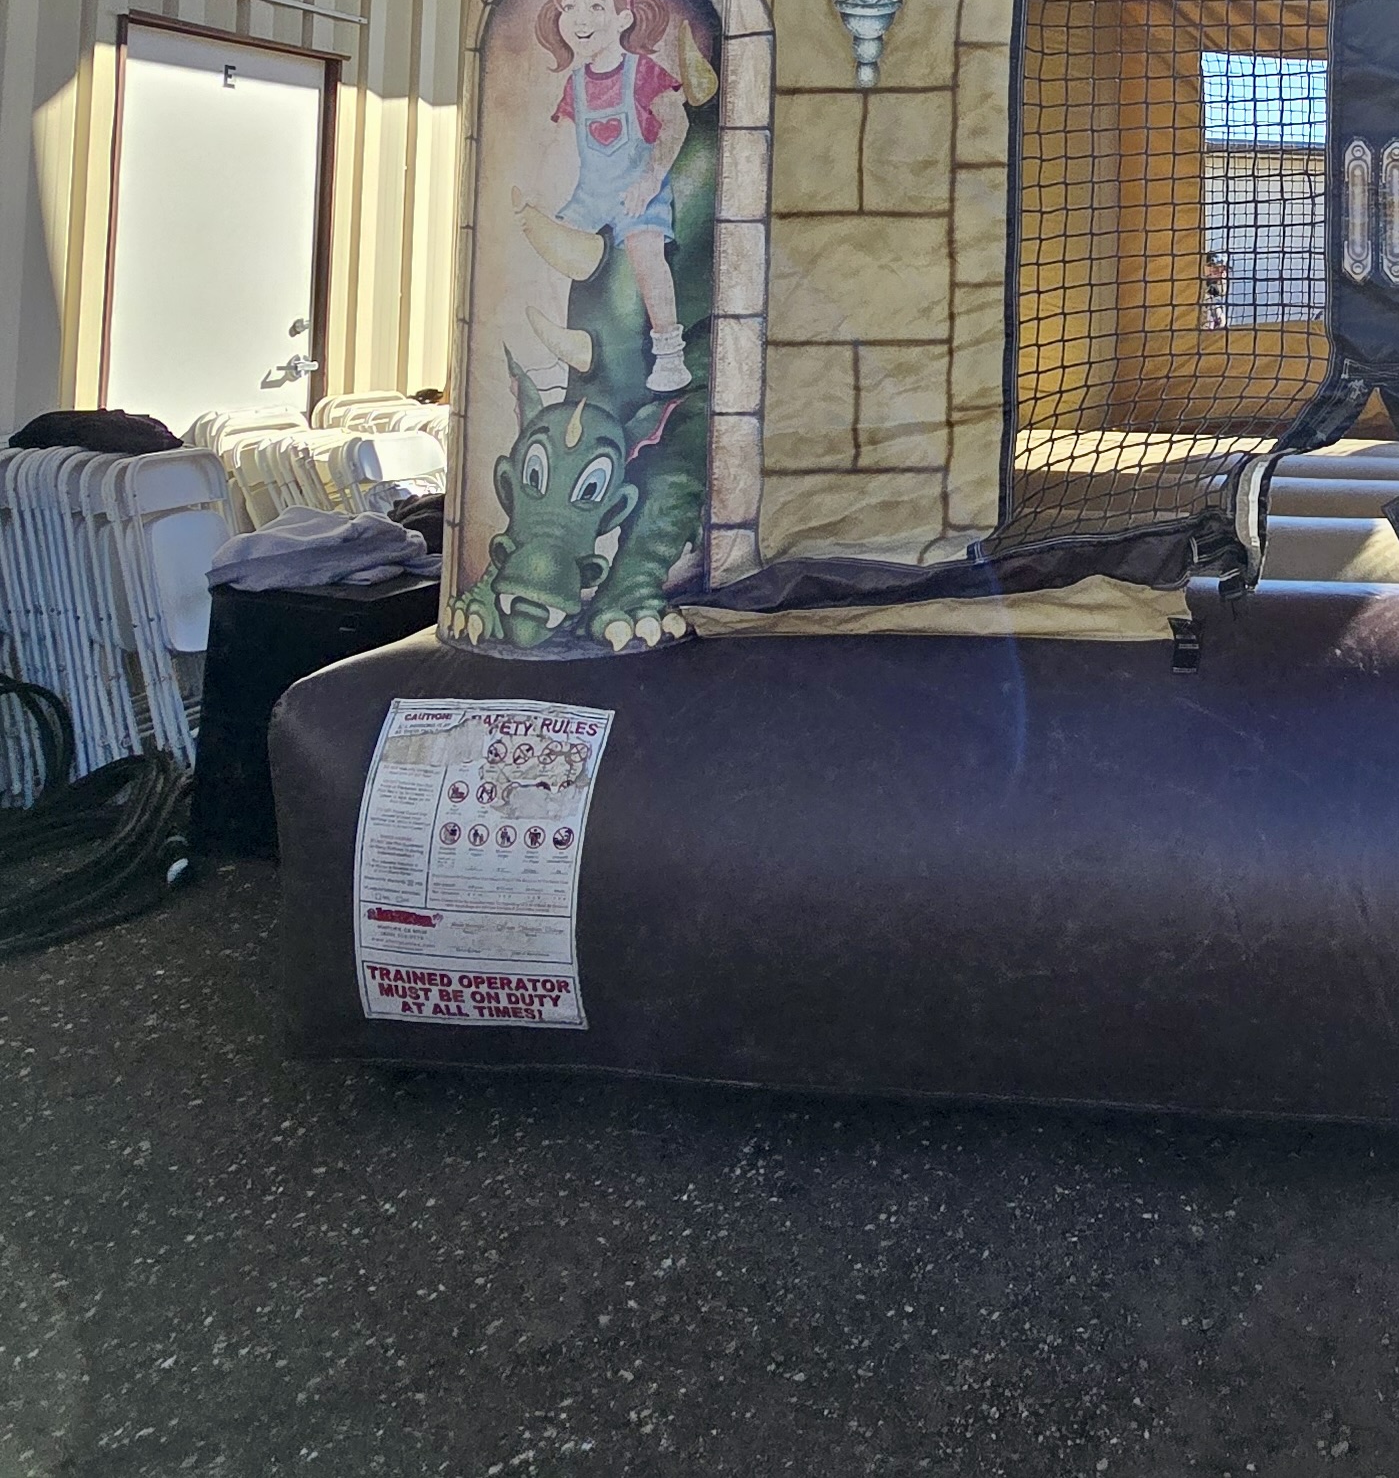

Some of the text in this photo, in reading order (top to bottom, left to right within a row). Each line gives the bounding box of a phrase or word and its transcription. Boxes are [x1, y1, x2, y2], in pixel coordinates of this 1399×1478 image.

[223, 64, 237, 89] E
[541, 717, 599, 737] RULES
[366, 965, 571, 994] TRAINED OPERATOR
[378, 982, 561, 1008] MUST BE ON DUTY
[401, 1000, 543, 1021] AT ALL TIMES!
